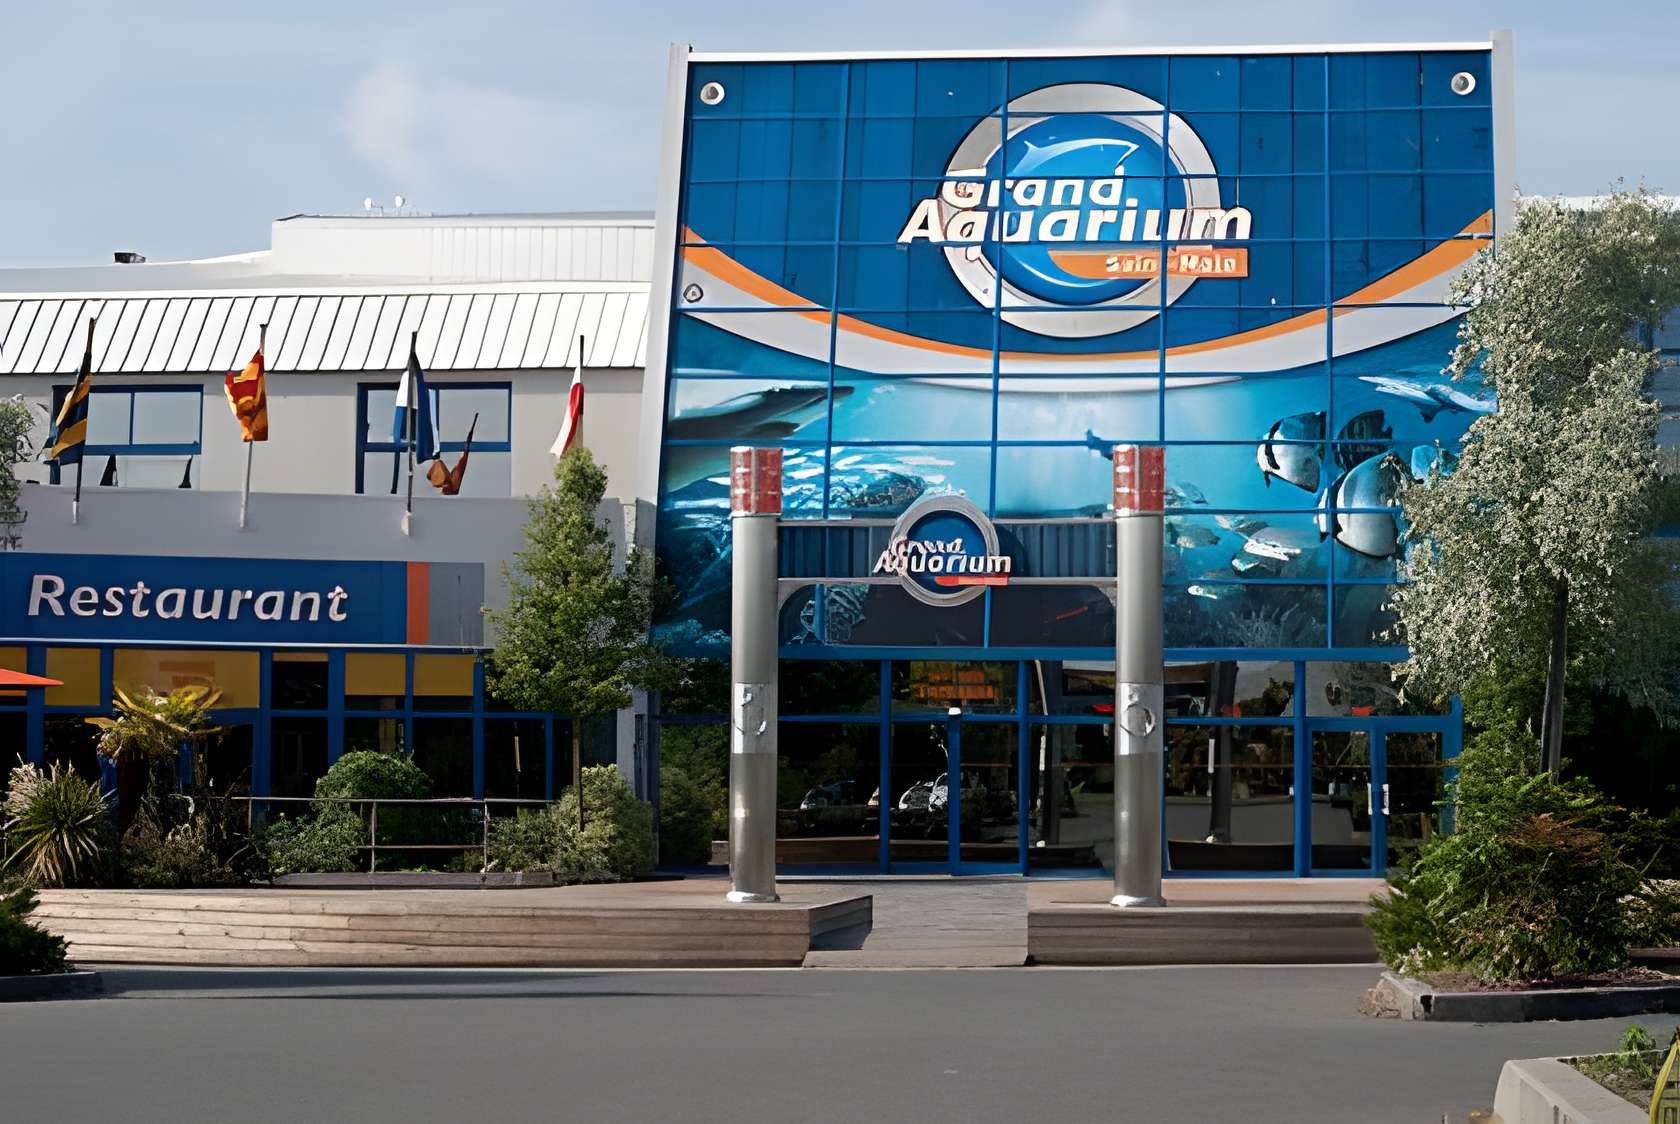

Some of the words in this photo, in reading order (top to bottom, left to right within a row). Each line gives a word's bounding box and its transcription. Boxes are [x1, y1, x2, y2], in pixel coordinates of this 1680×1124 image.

[942, 166, 1125, 208] Grand
[897, 198, 1252, 260] Aquarium
[27, 573, 349, 622] Restaurant
